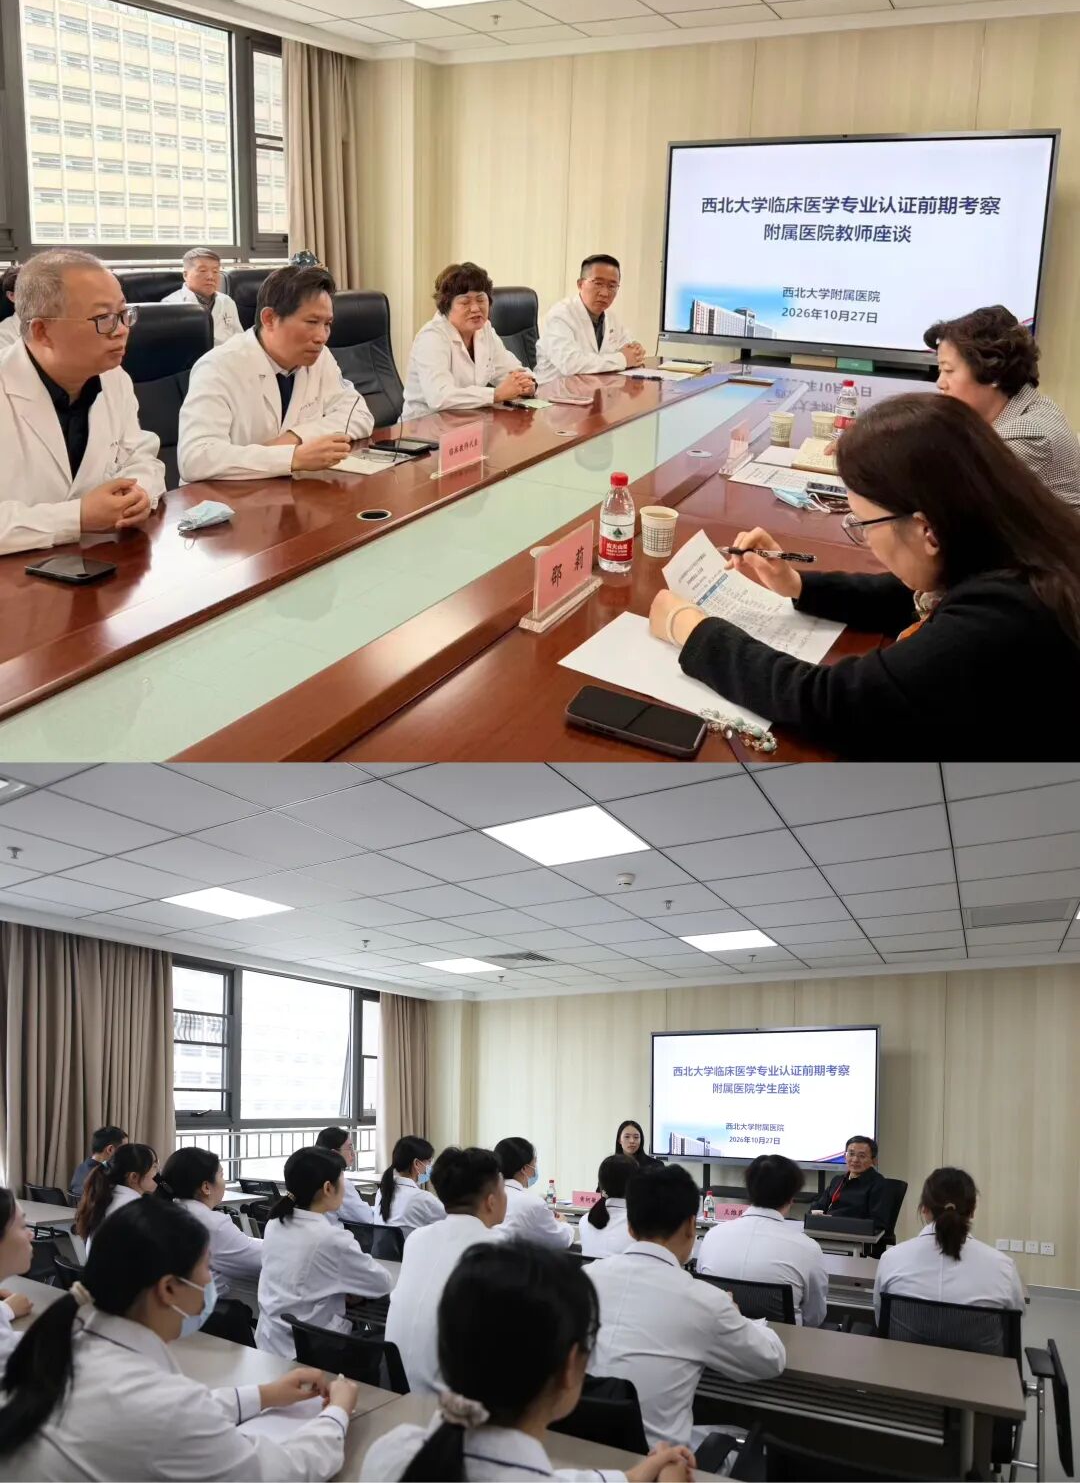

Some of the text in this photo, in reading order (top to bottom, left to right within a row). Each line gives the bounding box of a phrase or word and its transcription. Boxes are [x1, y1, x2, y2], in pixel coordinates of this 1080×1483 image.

[701, 195, 1001, 216] 西北大学临床医学专业认证前期考察
[763, 224, 912, 243] 附属医院教师座谈
[782, 286, 880, 303] 西北大学附属医院
[781, 307, 878, 324] 2026年10月27日
[673, 1064, 850, 1077] 西北大学临床医学专业认证前期考察
[712, 1082, 800, 1095] 附属医院学生座谈
[725, 1122, 785, 1132] 西北大学附属医院
[729, 1136, 781, 1145] 2026年10月27日
